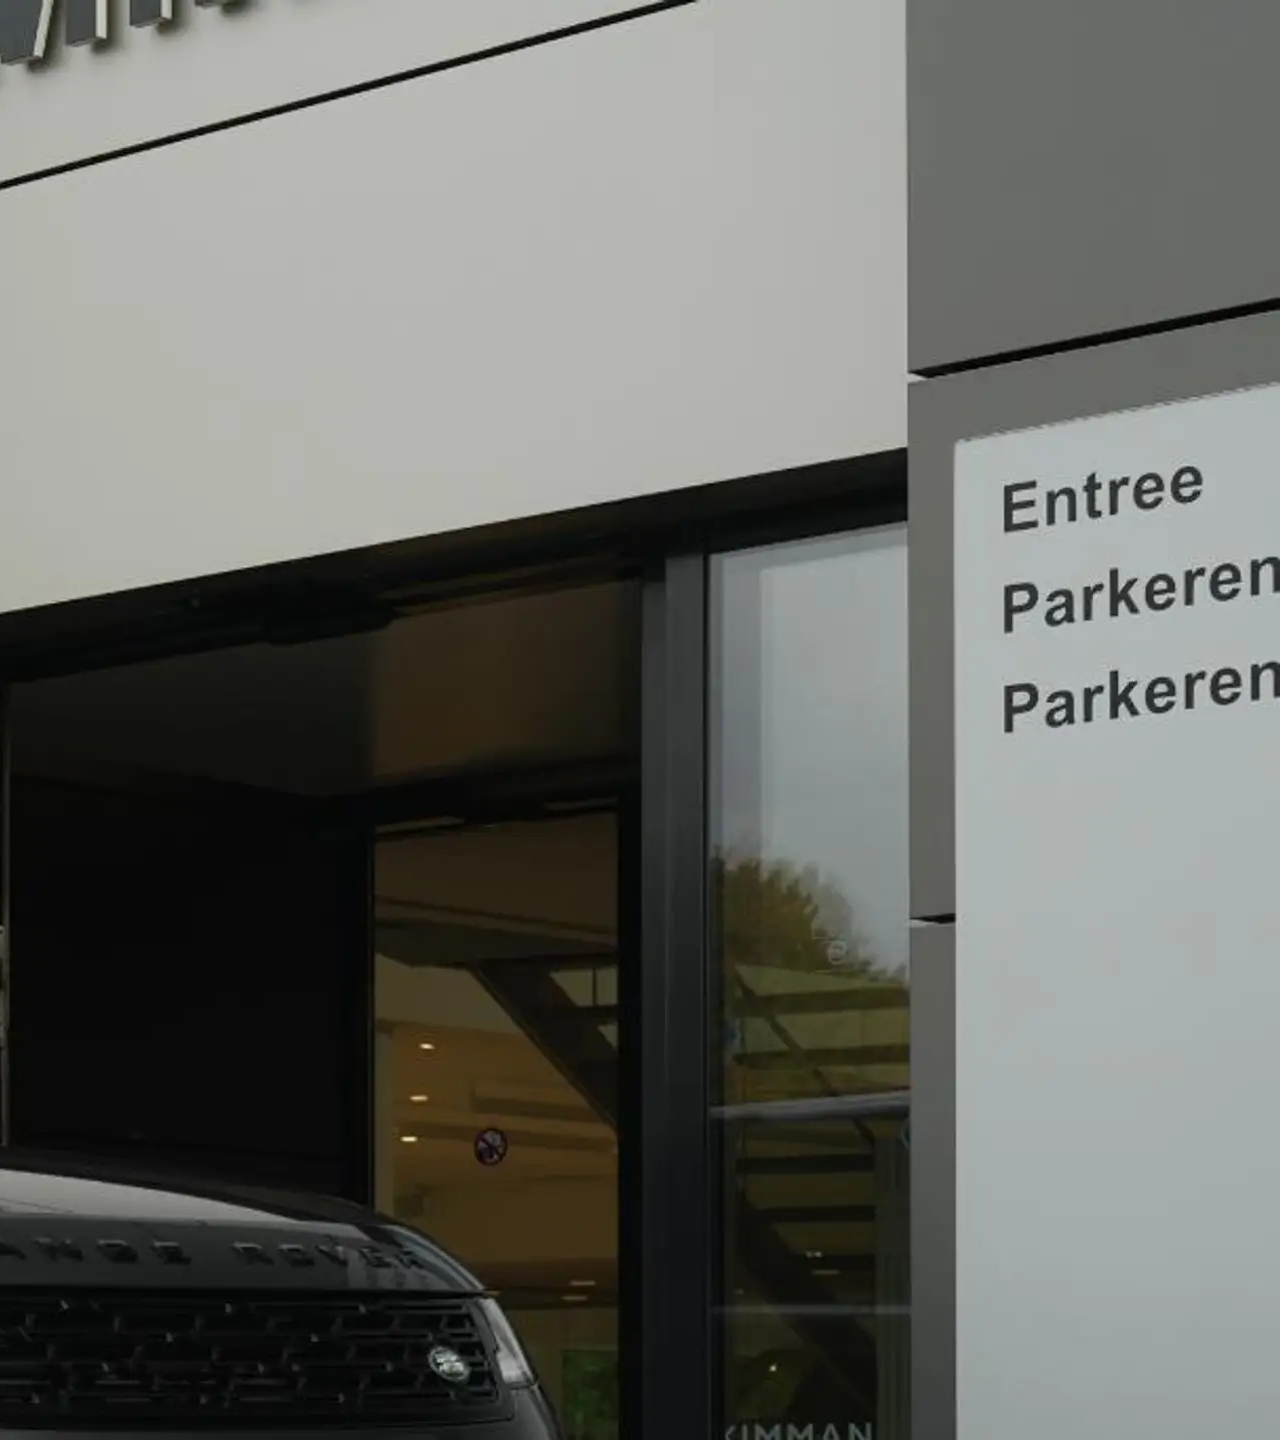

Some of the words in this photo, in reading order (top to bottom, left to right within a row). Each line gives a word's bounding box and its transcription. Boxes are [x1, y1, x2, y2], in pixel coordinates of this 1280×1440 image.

[1003, 464, 1204, 533] Entree
[1003, 555, 1280, 634] Parkeren
[1003, 658, 1280, 734] Parkeren
[231, 1236, 427, 1271] ROVER
